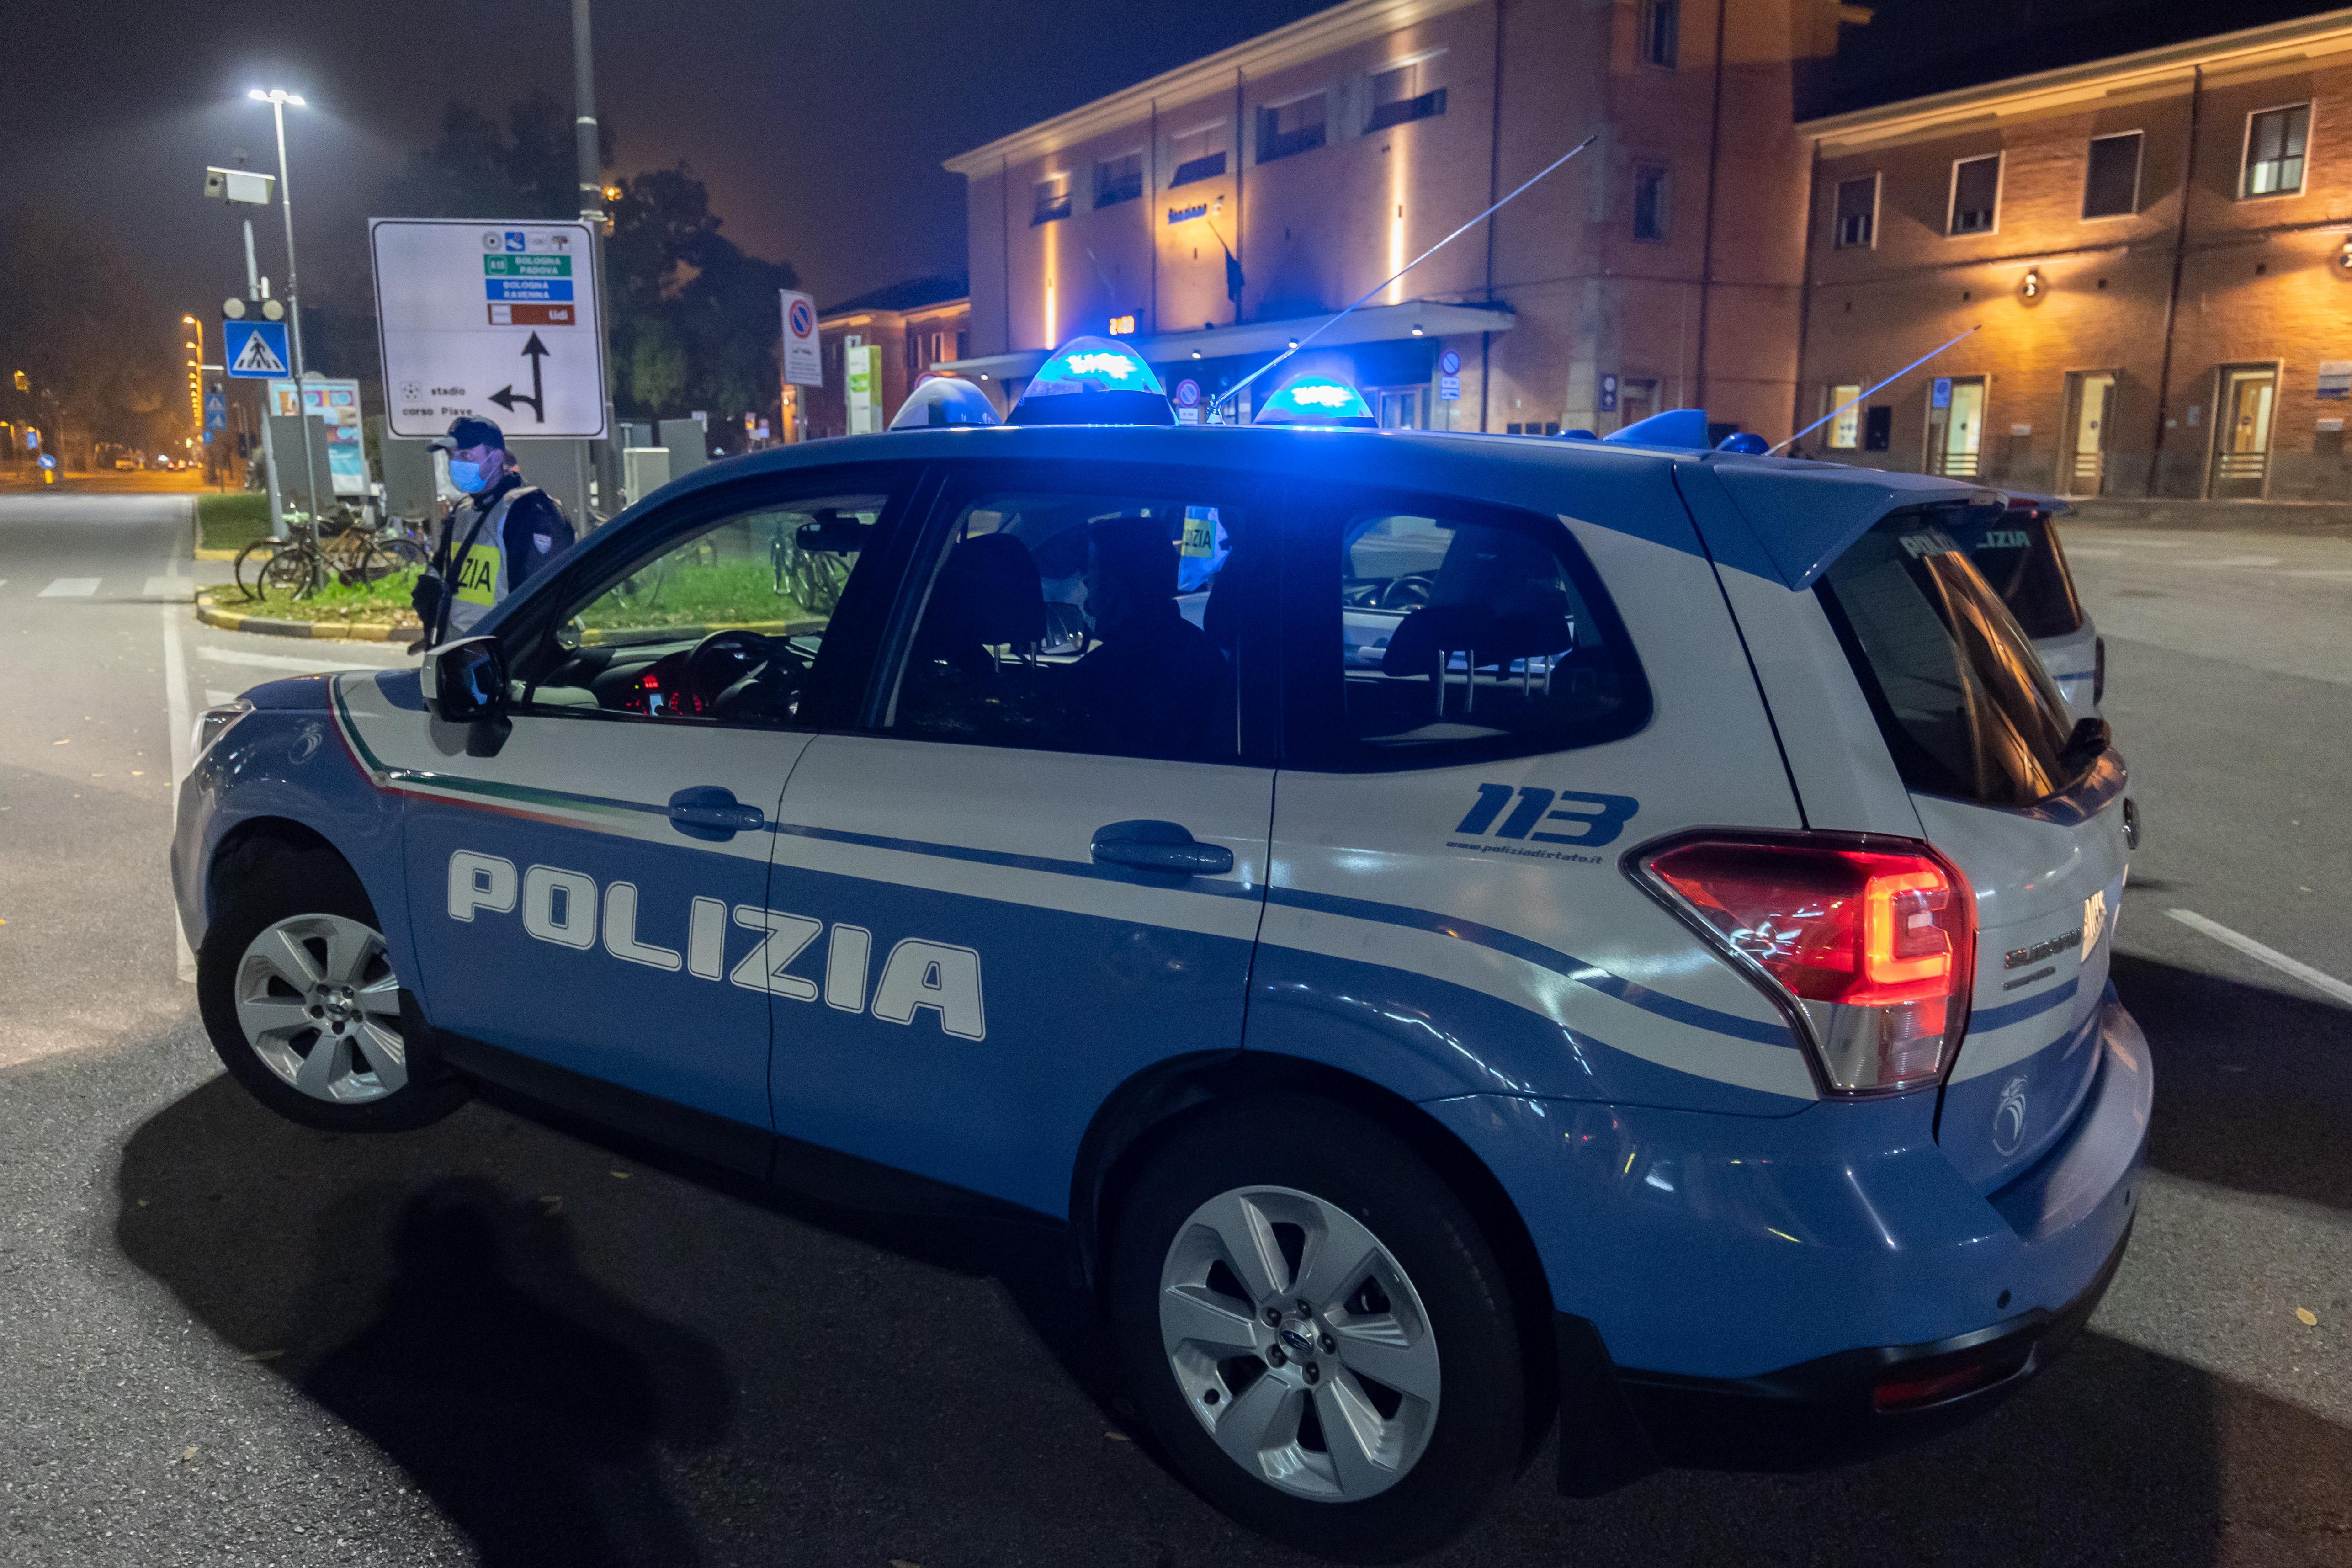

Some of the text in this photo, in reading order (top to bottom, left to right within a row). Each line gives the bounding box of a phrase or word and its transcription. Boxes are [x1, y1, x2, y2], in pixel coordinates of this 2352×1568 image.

[503, 281, 549, 289] BOLOGNA
[503, 291, 550, 299] RAVENNA
[431, 386, 465, 396] stadio
[441, 407, 473, 415] Piave
[1455, 782, 1640, 848] 113
[1446, 841, 1603, 864] www.poliziadistato.it
[448, 849, 986, 1041] POLIZIA
